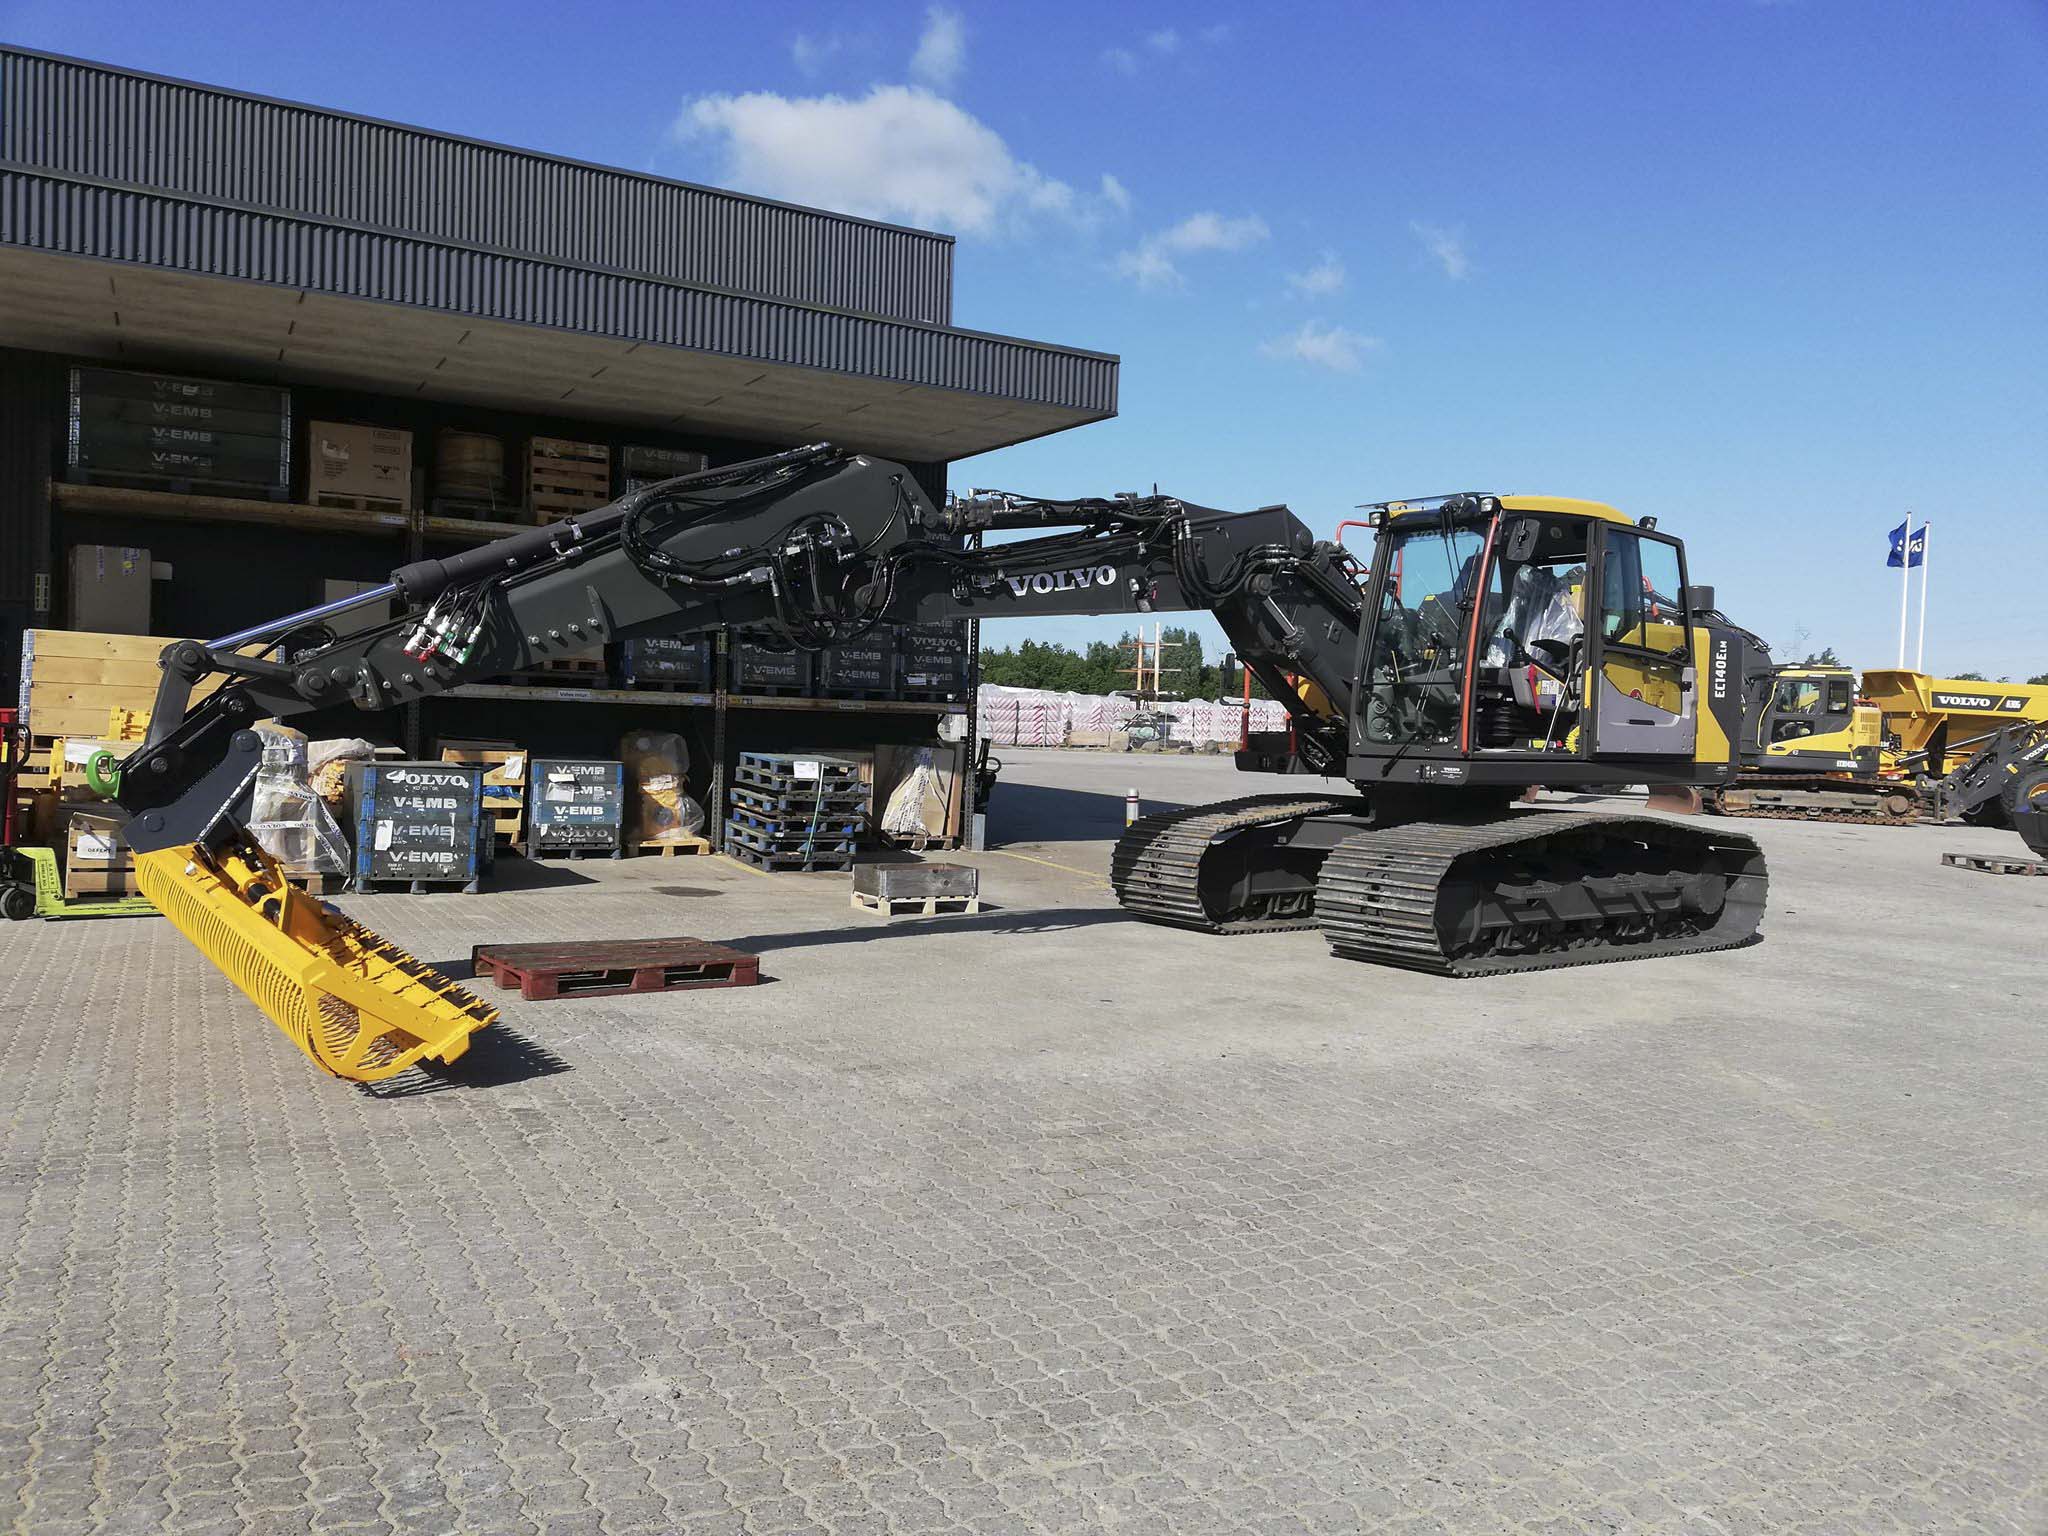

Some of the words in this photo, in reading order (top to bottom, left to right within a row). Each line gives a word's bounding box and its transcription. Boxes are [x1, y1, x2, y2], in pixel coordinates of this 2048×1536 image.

[153, 402, 213, 418] V-EMB
[152, 427, 213, 443] V-EMB
[1004, 564, 1117, 597] VOLVO
[646, 639, 693, 651] V-EM
[840, 650, 882, 661] V-EMB
[914, 656, 953, 664] V-EMB
[1937, 695, 1991, 707] VOLVO
[2021, 744, 2048, 761] VOLVO
[556, 764, 605, 775] V-EMB
[393, 796, 458, 809] V-EMB
[554, 806, 604, 815] V-EMB
[389, 851, 454, 863] V-EMB
